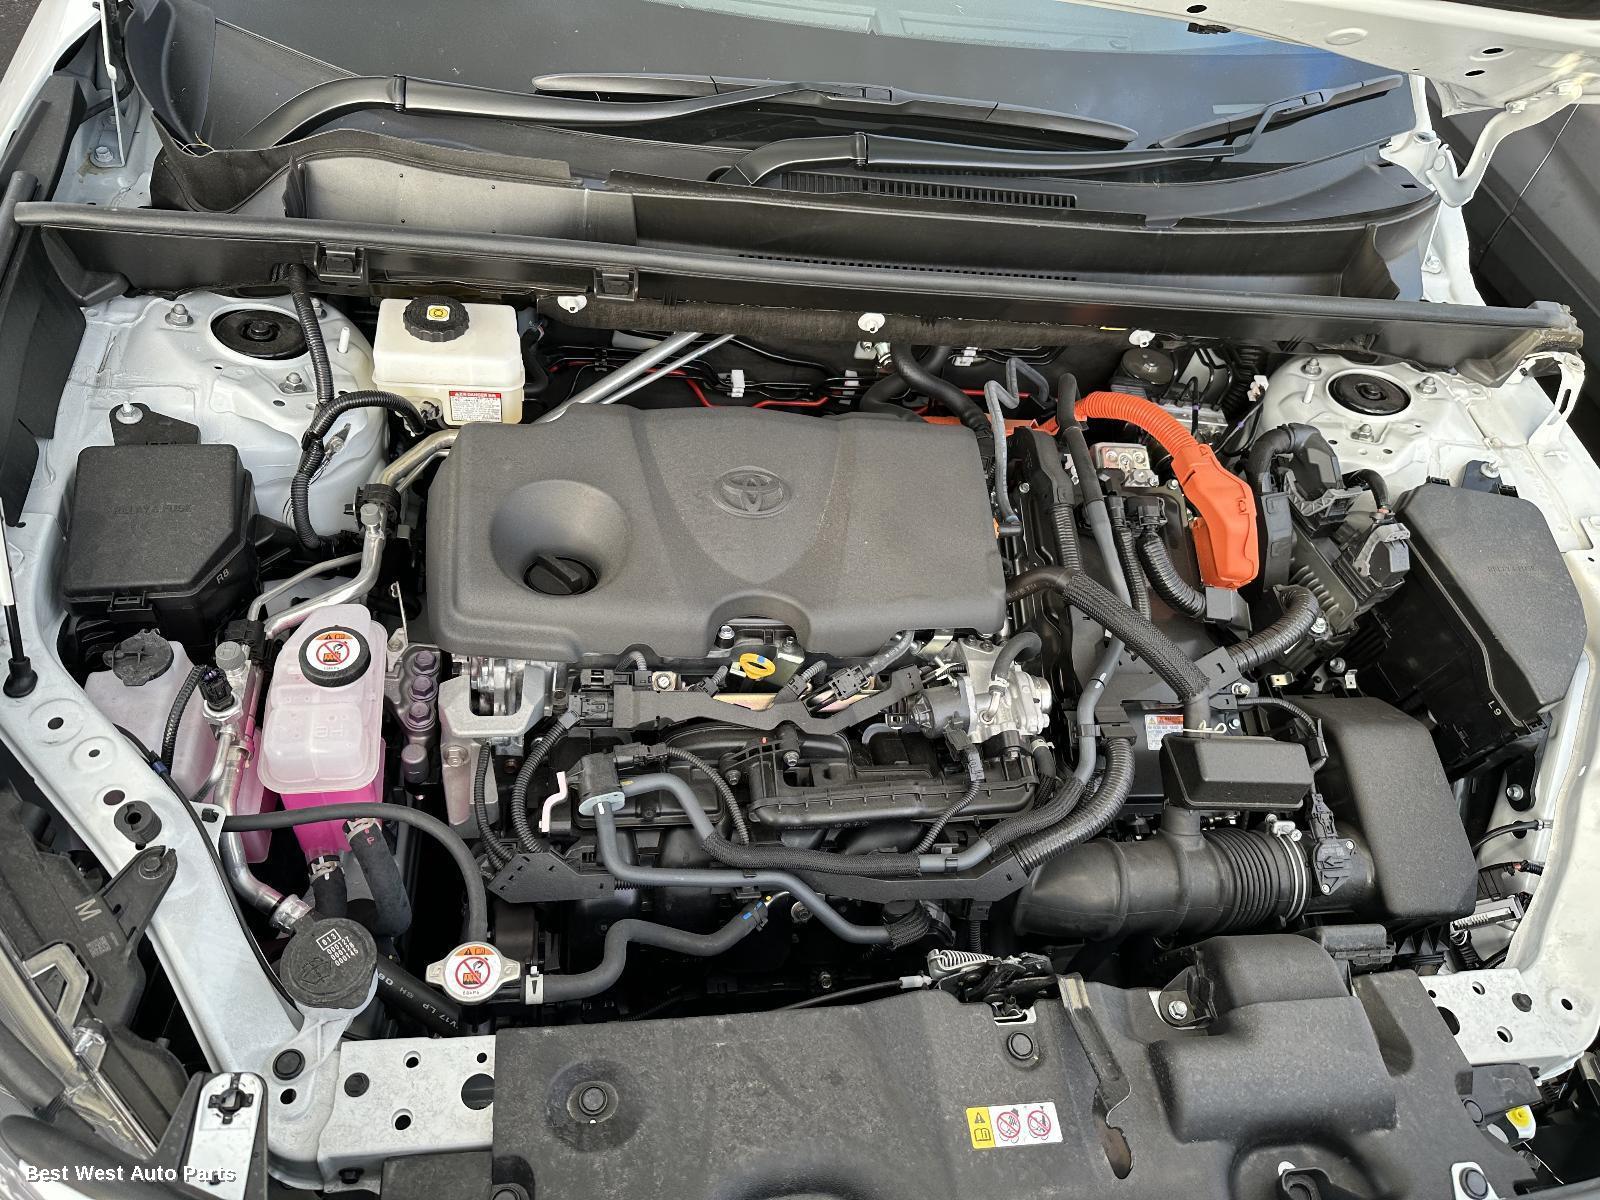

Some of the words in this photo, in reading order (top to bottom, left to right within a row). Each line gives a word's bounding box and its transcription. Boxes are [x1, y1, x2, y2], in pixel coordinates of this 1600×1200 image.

[216, 568, 230, 584] R8
[1488, 700, 1502, 716] L9
[75, 898, 102, 922] M
[326, 936, 350, 955] 000127
